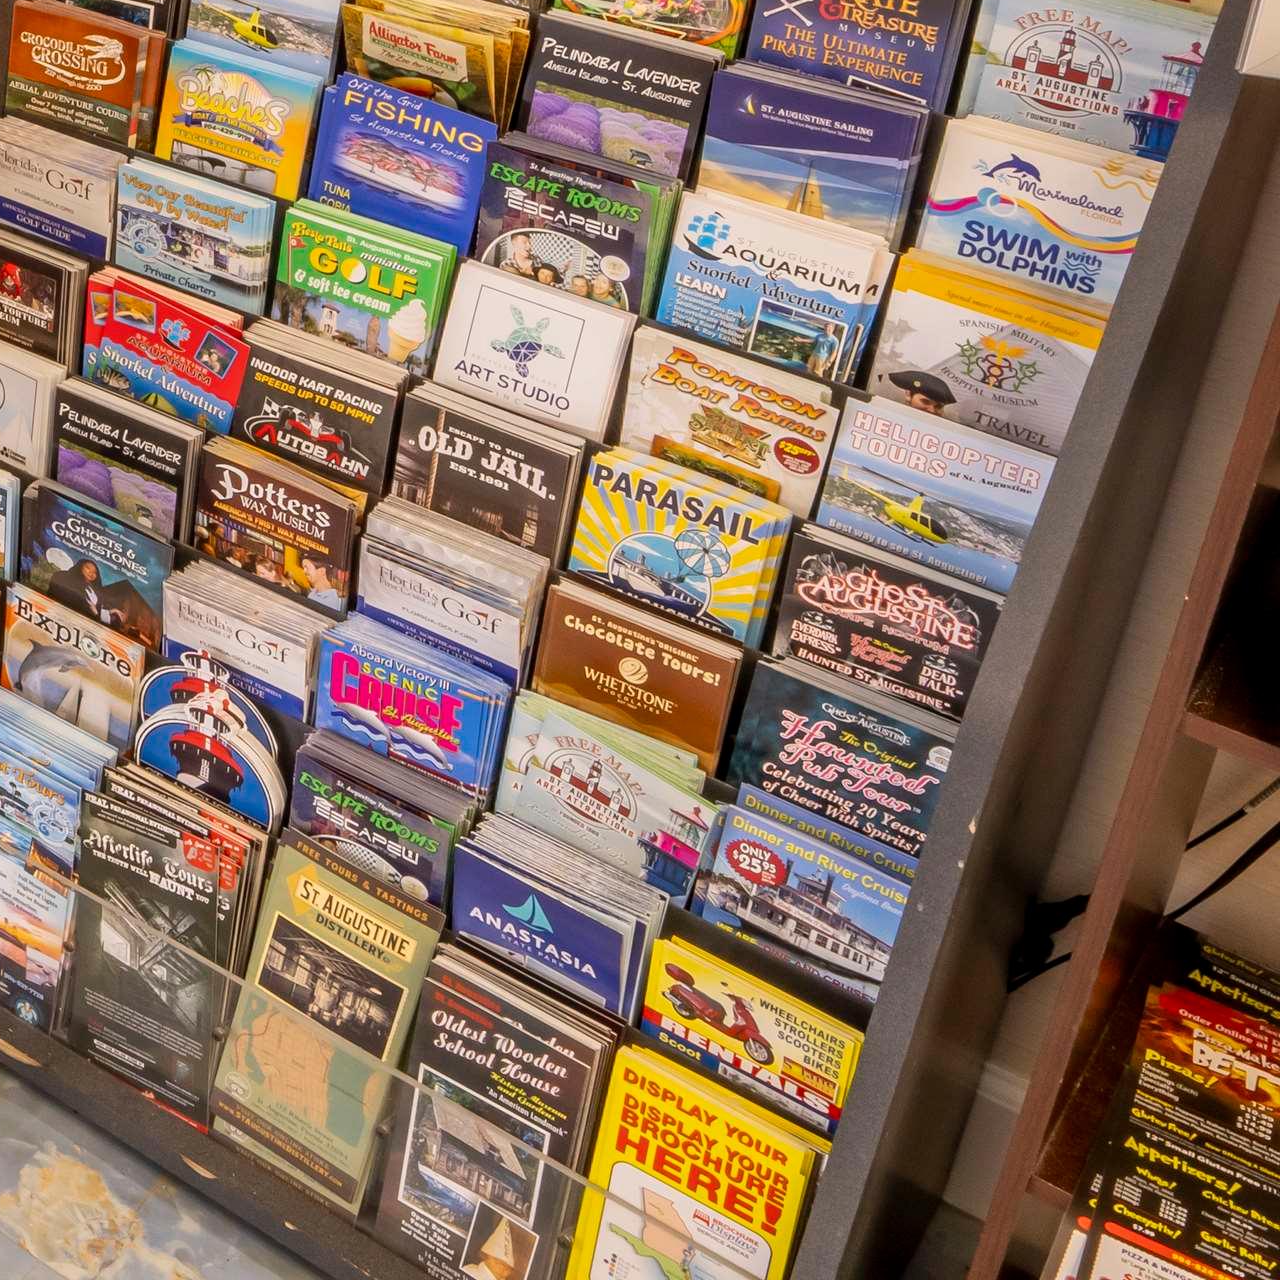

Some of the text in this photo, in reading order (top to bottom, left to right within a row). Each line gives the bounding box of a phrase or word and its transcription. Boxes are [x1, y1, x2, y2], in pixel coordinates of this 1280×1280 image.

[21, 32, 84, 55] CROCODILE
[32, 47, 108, 76] CROSSING
[369, 20, 421, 52] Alligator
[761, 35, 923, 86] PIRATE EXPERIENCE
[785, 24, 907, 65] THE ULTIMATE
[541, 37, 701, 95] PELINDABA LAVENDER
[1036, 76, 1109, 101] AUGUSTINE
[344, 91, 484, 153] FISHING
[1030, 86, 1120, 116] ATTRACTIONS
[490, 162, 642, 223] ESCAPE ROOMS
[360, 252, 418, 275] miniature
[723, 244, 860, 296] AQUARIUM
[958, 241, 1097, 295] DOLPHINS
[962, 220, 1103, 269] SWIM with
[309, 246, 419, 299] GOLF
[676, 272, 728, 299] LEARN
[688, 259, 752, 289] Snorkel
[754, 279, 845, 319] Adventure
[3, 306, 48, 330] TORTURE
[251, 357, 383, 415] INDOOR KART RACING
[454, 359, 570, 411] ART STUDIO
[649, 363, 828, 443] BOAT RENTALS
[666, 346, 828, 420] PONTOON
[59, 402, 182, 466] PELINDABA LAVENDER
[255, 423, 370, 477] AUTOBAHN
[850, 430, 948, 478] TOURS
[855, 410, 1041, 489] HELICOPTER
[974, 409, 1050, 448] TRAVEL
[418, 426, 548, 500] OLD JAIL
[211, 463, 331, 527] Potter's
[592, 465, 760, 546] PARASAIL
[51, 521, 147, 577] GRAVESTONES
[67, 517, 125, 553] GHOSTS
[330, 651, 463, 753] CRUISE
[362, 664, 438, 701] SCENIC
[584, 666, 674, 714] WHETSTONE
[11, 766, 65, 806] Tours
[763, 762, 854, 813] Celebrating
[732, 815, 784, 846] Dinner
[83, 830, 214, 894] Afterlife Tours
[316, 912, 385, 962] DISTILLERY
[469, 906, 597, 980] ANASTASIA
[431, 1009, 569, 1079] Oldest Wooden
[759, 998, 846, 1049] WHEELCHAIRS
[774, 1018, 843, 1060] STROLLERS
[1215, 1022, 1252, 1042] Online
[433, 1032, 561, 1098] School House
[660, 1016, 831, 1115] RENTALS
[777, 1030, 841, 1070] SCOOTERS
[803, 1055, 840, 1080] BIKES
[1145, 1048, 1218, 1089] Pizzas!
[623, 1066, 788, 1166] DISPLAY YOUR
[620, 1107, 788, 1206] BROCHURE
[1124, 1136, 1242, 1195] Appetizers!
